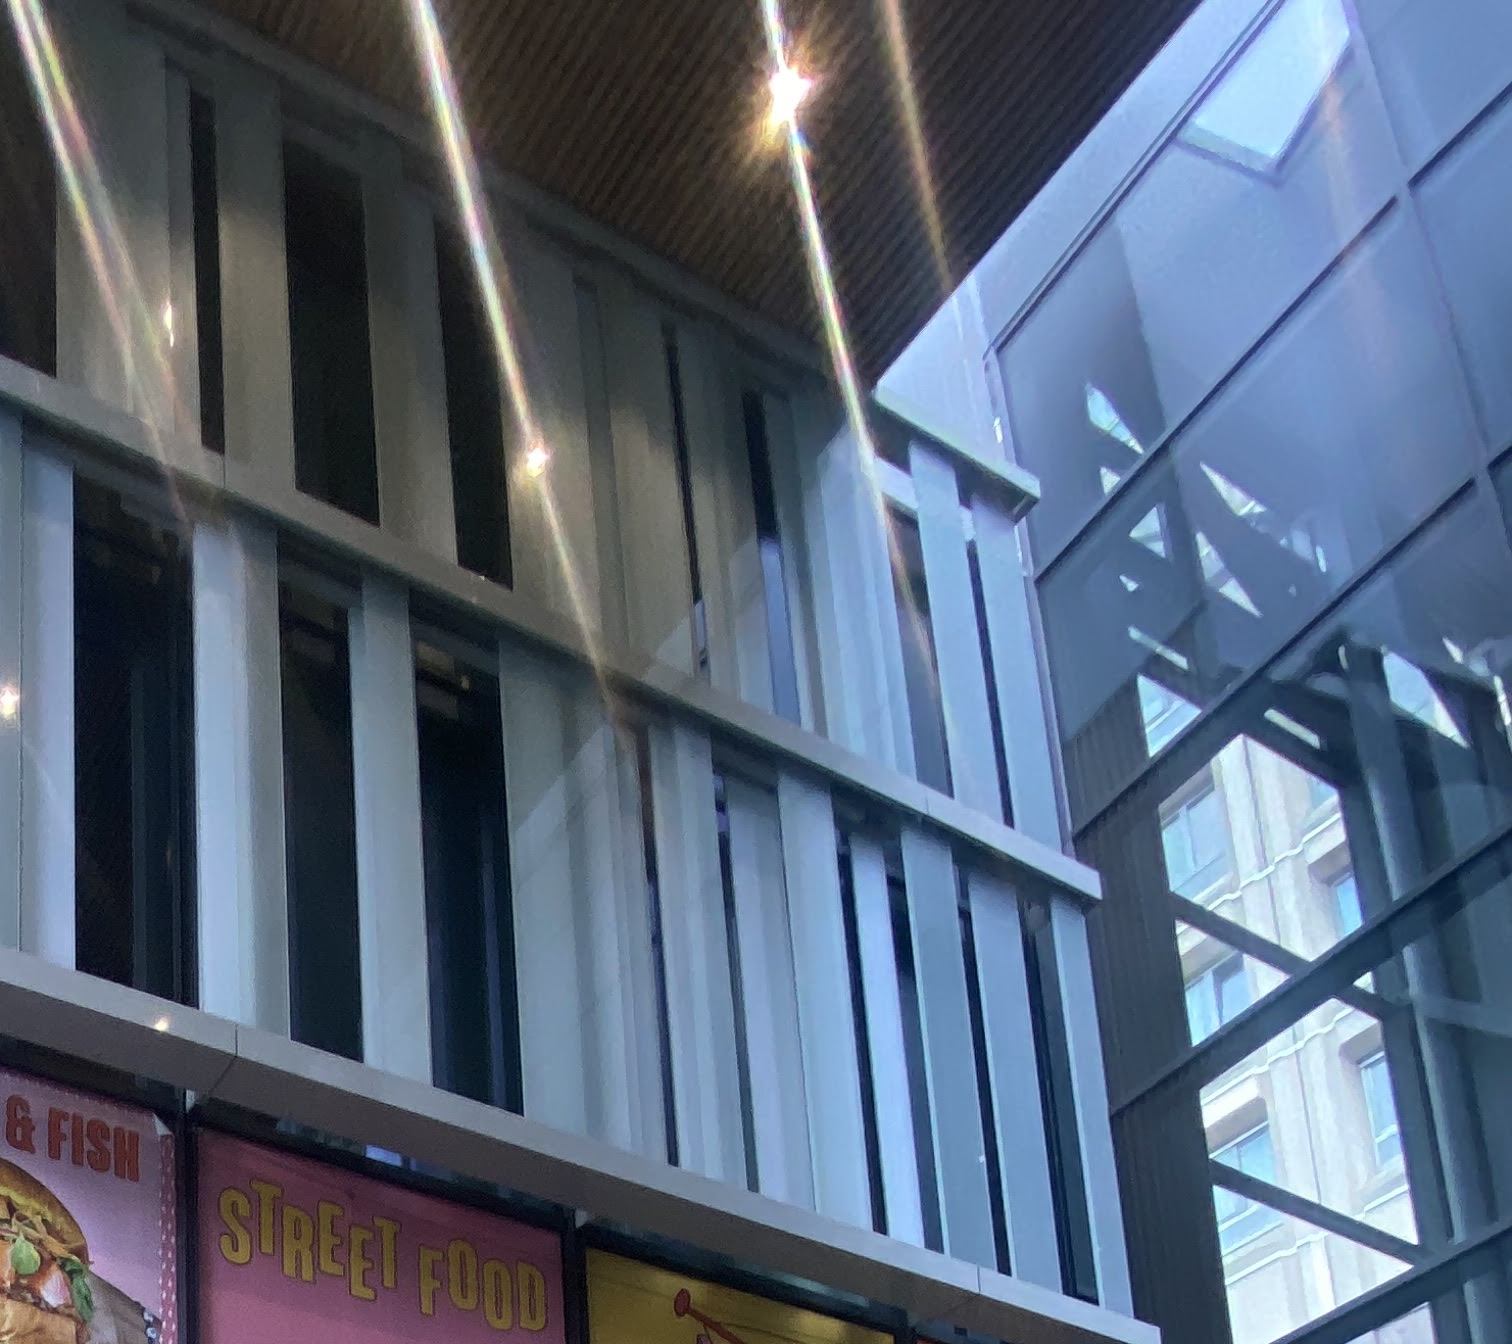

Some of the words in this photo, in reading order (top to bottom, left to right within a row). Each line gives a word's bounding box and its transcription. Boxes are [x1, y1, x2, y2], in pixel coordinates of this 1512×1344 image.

[5, 1094, 36, 1154] &
[47, 1108, 140, 1182] FISH
[218, 1179, 402, 1300] STREET
[418, 1239, 547, 1332] FOOD
